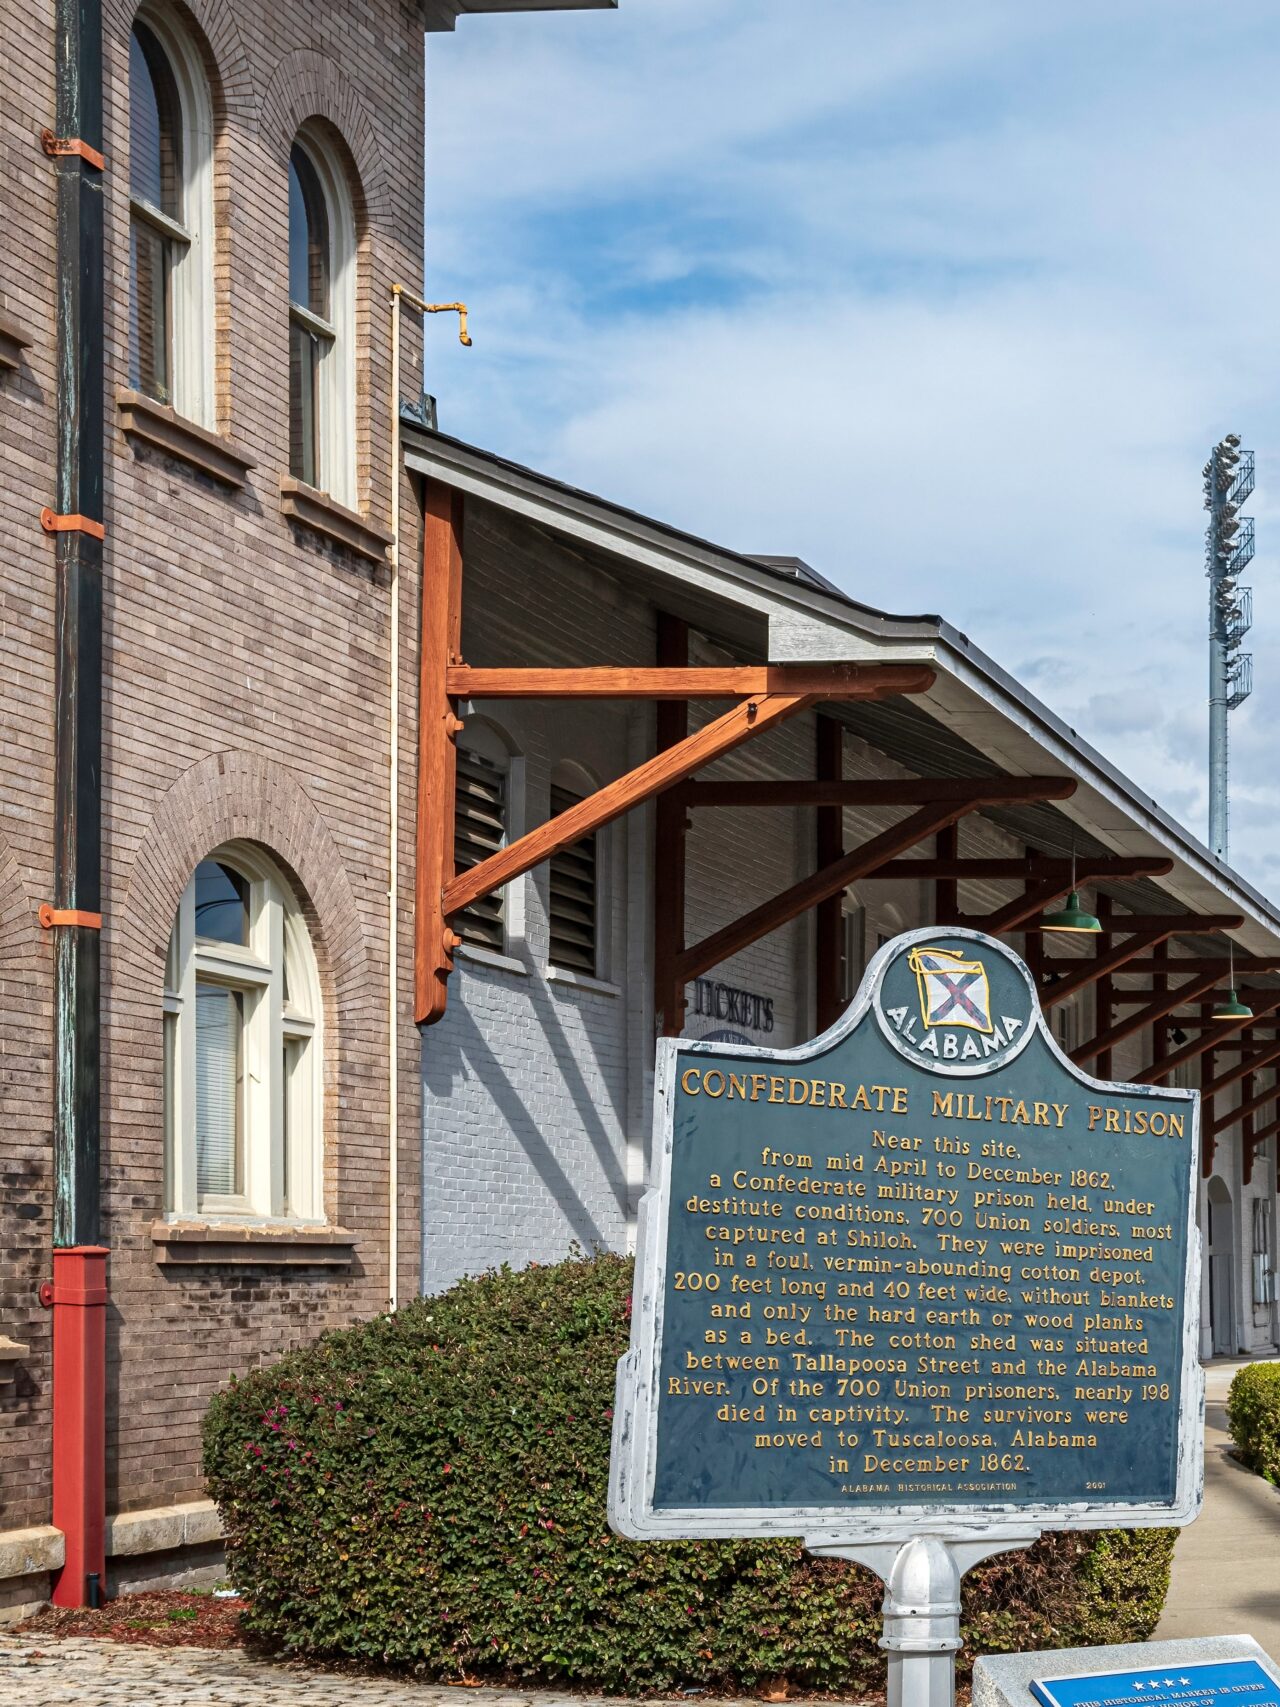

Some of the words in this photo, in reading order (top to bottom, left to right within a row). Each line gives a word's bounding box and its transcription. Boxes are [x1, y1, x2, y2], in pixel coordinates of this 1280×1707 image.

[694, 979, 774, 1033] TICKETS
[885, 1006, 1023, 1061] ALABAMA
[681, 1068, 908, 1114] CONFEDERATE
[932, 1091, 1068, 1129] MILITARY
[1089, 1105, 1184, 1137] PRISON
[872, 1130, 923, 1152] Near
[934, 1136, 970, 1155] this
[981, 1141, 1021, 1160] site,
[762, 1146, 813, 1169] from
[827, 1153, 864, 1172] mid
[876, 1156, 927, 1177] April
[937, 1162, 956, 1178] to
[968, 1162, 1061, 1185] December
[710, 1174, 721, 1188] a
[733, 1170, 865, 1197] Confederate
[878, 1183, 958, 1205] military
[974, 1190, 1034, 1208] prison
[1104, 1200, 1154, 1215] under
[687, 1196, 782, 1217] destitute
[795, 1204, 909, 1225] conditions,
[921, 1207, 963, 1227] 700
[975, 1212, 1030, 1231] Union
[1131, 1225, 1172, 1240] most
[705, 1225, 805, 1246] captured
[817, 1229, 837, 1245] at
[848, 1229, 916, 1249] Shiloh.
[938, 1233, 988, 1256] They
[1000, 1242, 1045, 1256] were
[1055, 1243, 1153, 1262] imprisoned
[715, 1247, 735, 1267] in
[745, 1253, 757, 1268] a
[824, 1258, 1012, 1284] vermin-abounding
[1021, 1265, 1080, 1281] cotton
[674, 1271, 720, 1292] 200
[731, 1274, 771, 1295] feet
[781, 1277, 826, 1301] long
[838, 1281, 874, 1297] and
[884, 1280, 910, 1299] 40
[919, 1282, 956, 1300] feet
[1021, 1287, 1089, 1306] without
[1101, 1290, 1174, 1309] blankets
[710, 1302, 751, 1319] and
[763, 1302, 812, 1323] only
[824, 1304, 857, 1322] the
[868, 1307, 916, 1324] hard
[926, 1309, 981, 1326] earth
[992, 1313, 1012, 1326] or
[1025, 1314, 1073, 1329] wood
[1084, 1314, 1143, 1334] planks
[705, 1330, 727, 1344] as
[741, 1331, 752, 1344] a
[766, 1328, 810, 1345] bed.
[835, 1328, 874, 1347] The
[889, 1333, 956, 1350] cotton
[970, 1334, 1016, 1352] shed
[1030, 1339, 1064, 1353] was
[1076, 1337, 1148, 1355] situated
[687, 1351, 779, 1372] between
[793, 1353, 907, 1376] Tallapoosa
[918, 1356, 979, 1375] Street
[992, 1360, 1026, 1375] and
[1037, 1360, 1066, 1376] the
[1076, 1360, 1157, 1377] Alabama
[668, 1376, 730, 1396] River.
[752, 1377, 779, 1396] Of
[790, 1379, 824, 1397] the
[837, 1378, 880, 1397] 700
[895, 1379, 950, 1398] Union
[965, 1383, 1060, 1402] prisoners,
[1075, 1385, 1132, 1404] nearly
[1142, 1384, 1169, 1401] 198
[716, 1404, 765, 1422] died
[778, 1406, 796, 1423] in
[809, 1405, 909, 1426] captivity.
[930, 1404, 969, 1423] The
[983, 1406, 1072, 1424] survivors
[1086, 1411, 1128, 1424] were
[755, 1431, 822, 1449] moved
[838, 1431, 859, 1448] to
[1011, 1430, 1097, 1448] Alabama
[830, 1456, 848, 1473] in
[864, 1455, 970, 1473] December
[981, 1453, 1030, 1472] 1862.
[841, 1484, 890, 1493] ALABAMA
[898, 1483, 952, 1492] HISTORICAL
[957, 1482, 1017, 1491] ASSOCIATION
[1086, 1481, 1106, 1489] 2001
[1103, 1694, 1168, 1706] HISTORICAL
[1170, 1688, 1217, 1699] MARKER
[1231, 1683, 1265, 1693] GIVEN
